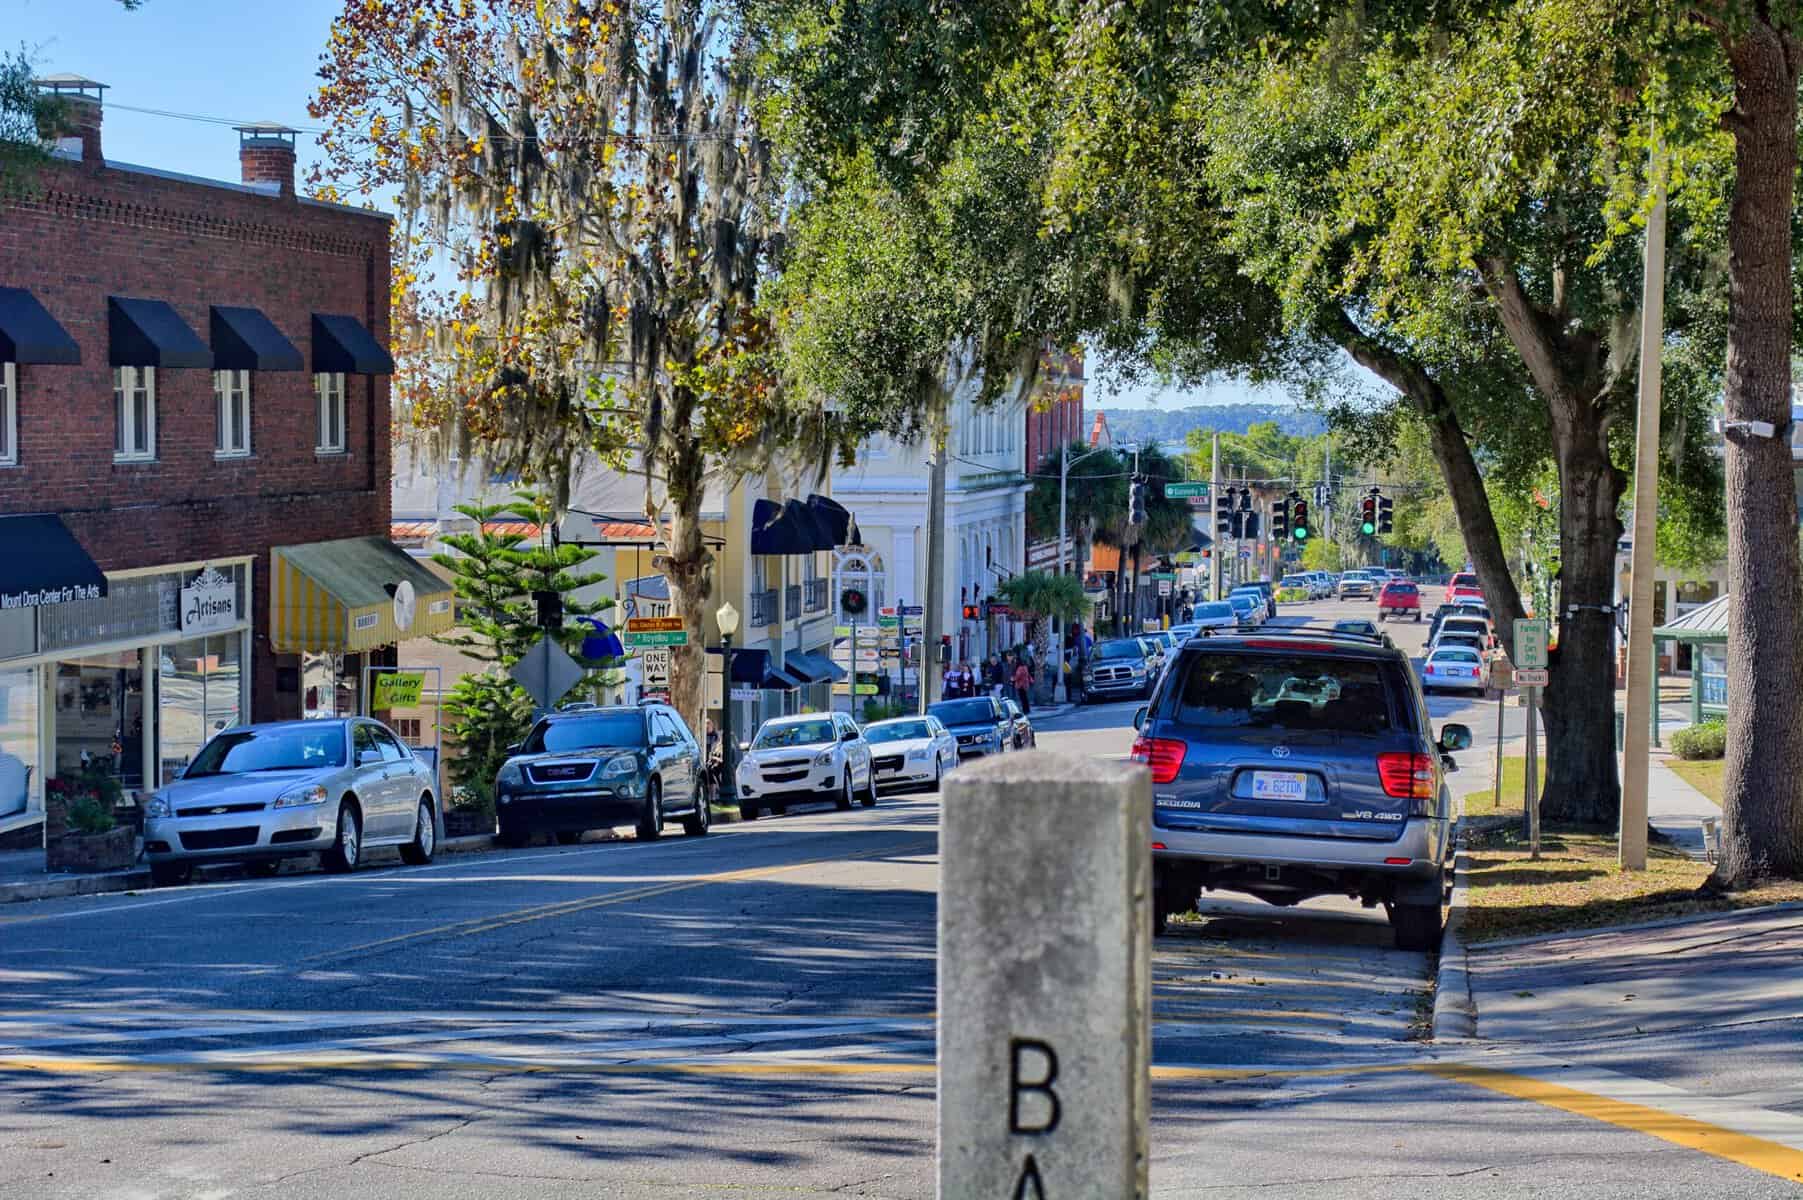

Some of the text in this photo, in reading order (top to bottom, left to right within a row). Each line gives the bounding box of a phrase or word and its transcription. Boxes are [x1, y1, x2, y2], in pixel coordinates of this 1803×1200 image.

[1, 583, 100, 608] Mount Dora Center For The Arts
[186, 595, 232, 624] Artisans
[646, 653, 667, 663] ONE
[646, 663, 667, 673] WAY
[379, 677, 421, 689] Gallery
[390, 693, 417, 704] Gifts
[1156, 799, 1201, 809] SEQUOIA
[1374, 812, 1402, 820] 4WD
